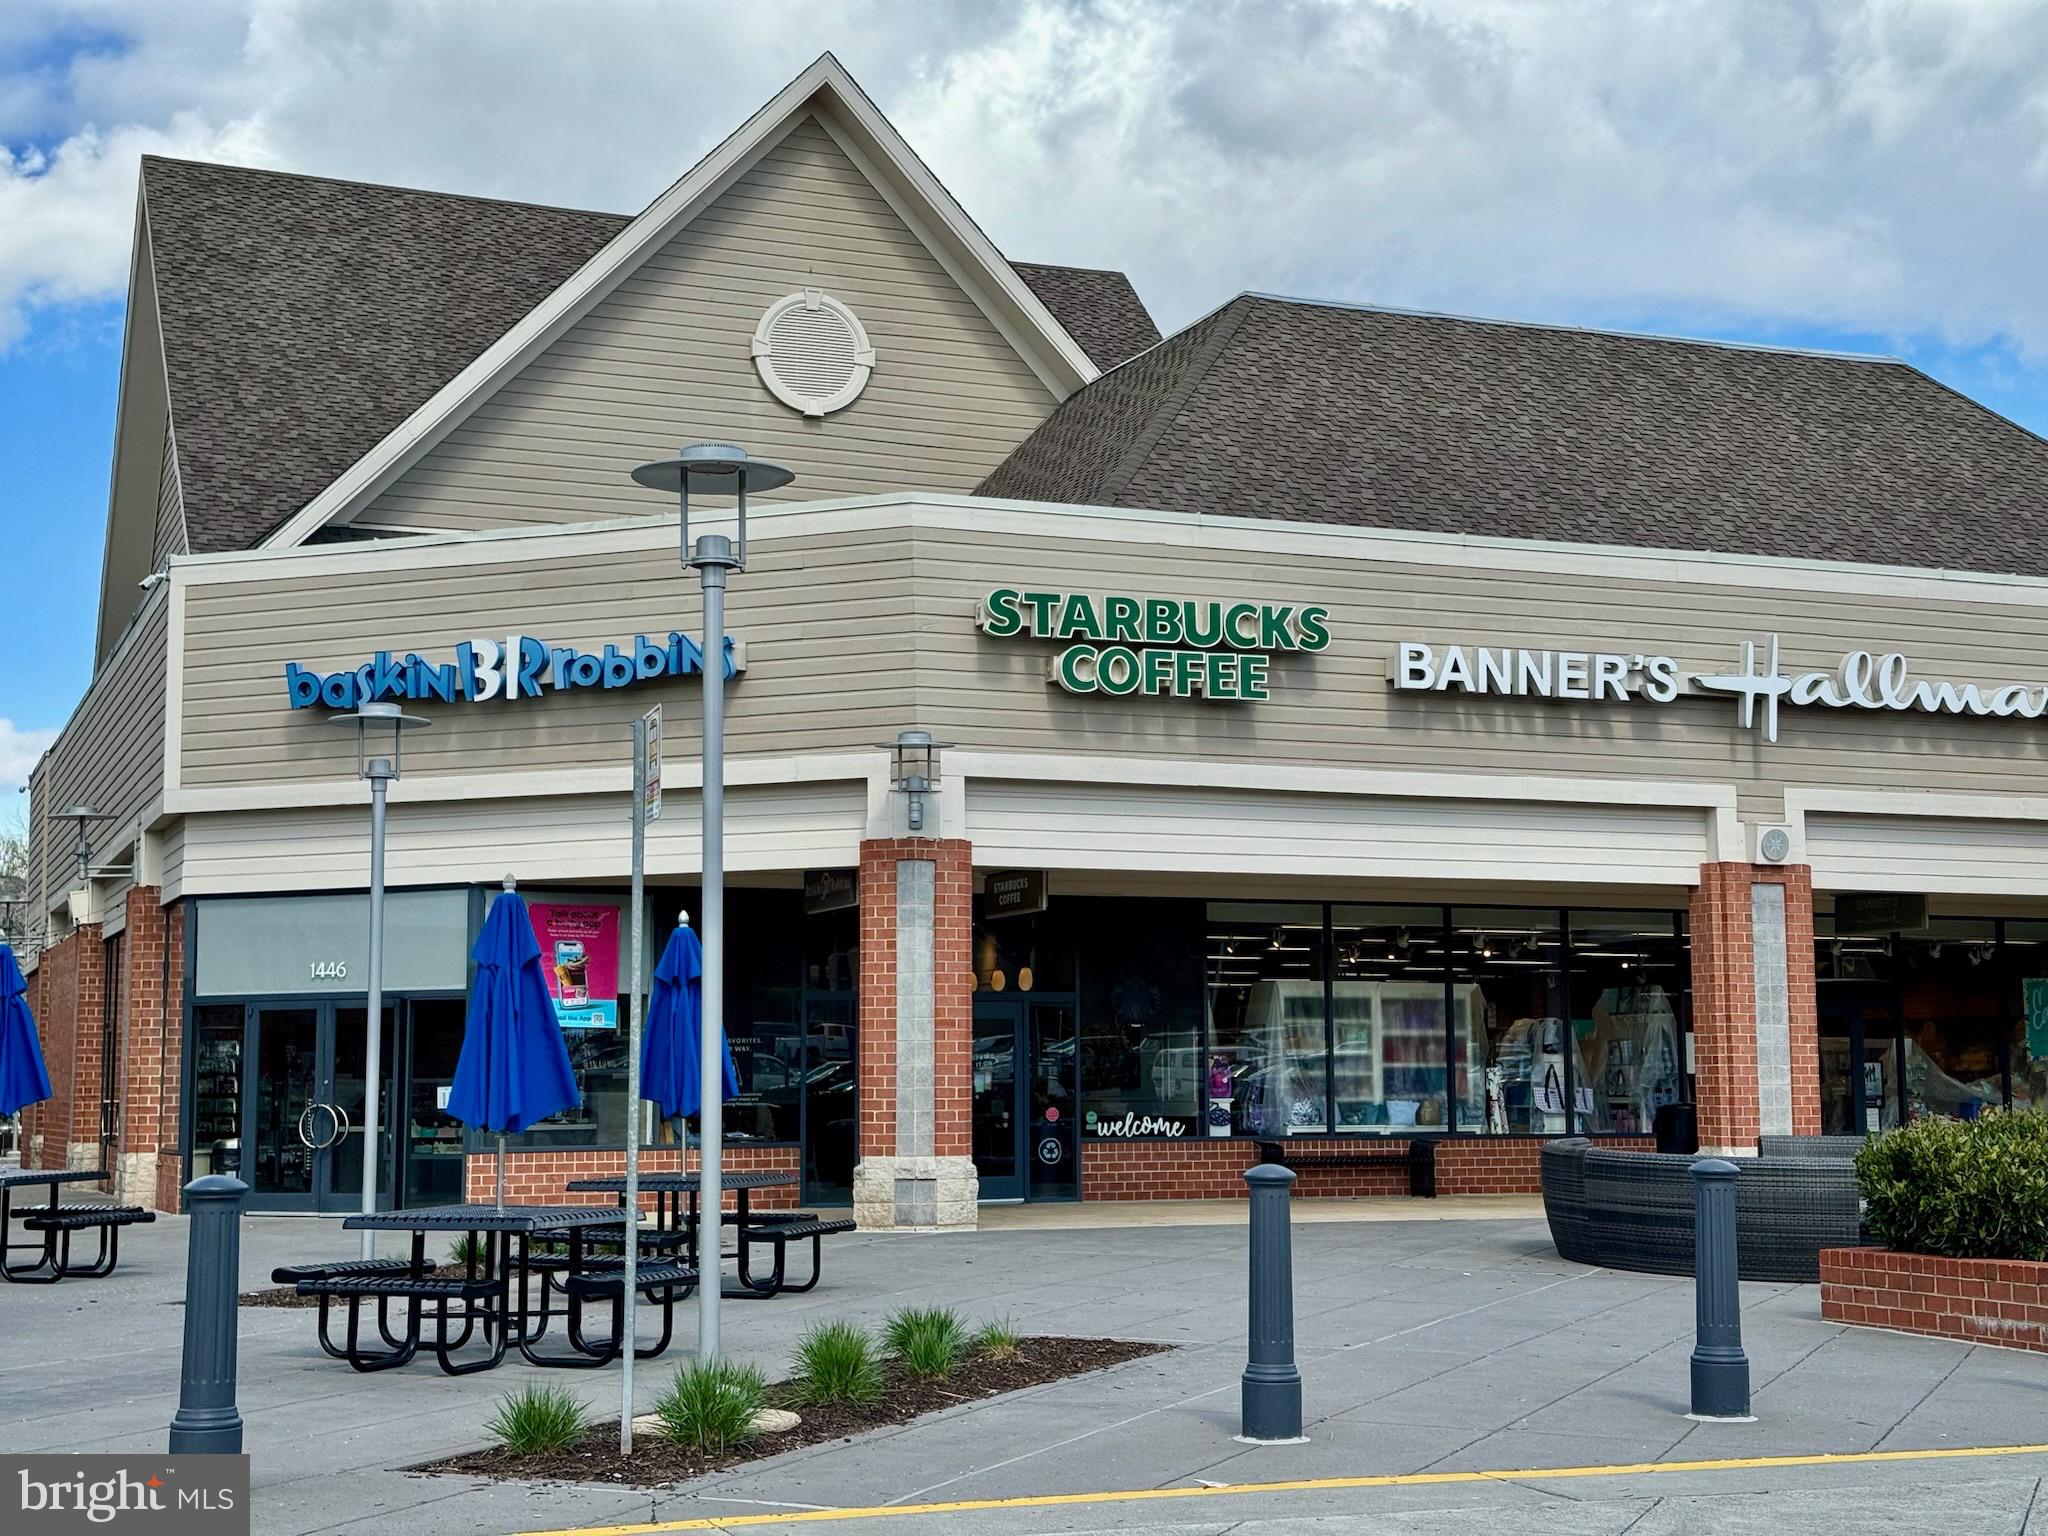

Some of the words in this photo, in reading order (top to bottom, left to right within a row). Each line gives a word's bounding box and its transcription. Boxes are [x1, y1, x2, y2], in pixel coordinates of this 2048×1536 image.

[986, 588, 1332, 652] STARBUCKS
[1057, 644, 1270, 701] COFFEE
[1392, 642, 1680, 703] BANNER'S
[1692, 632, 2048, 743] Hallma
[993, 877, 1028, 894] STARBUCKS
[999, 892, 1021, 906] COFFEE
[310, 961, 347, 978] 1446
[1097, 1112, 1186, 1138] welcome
